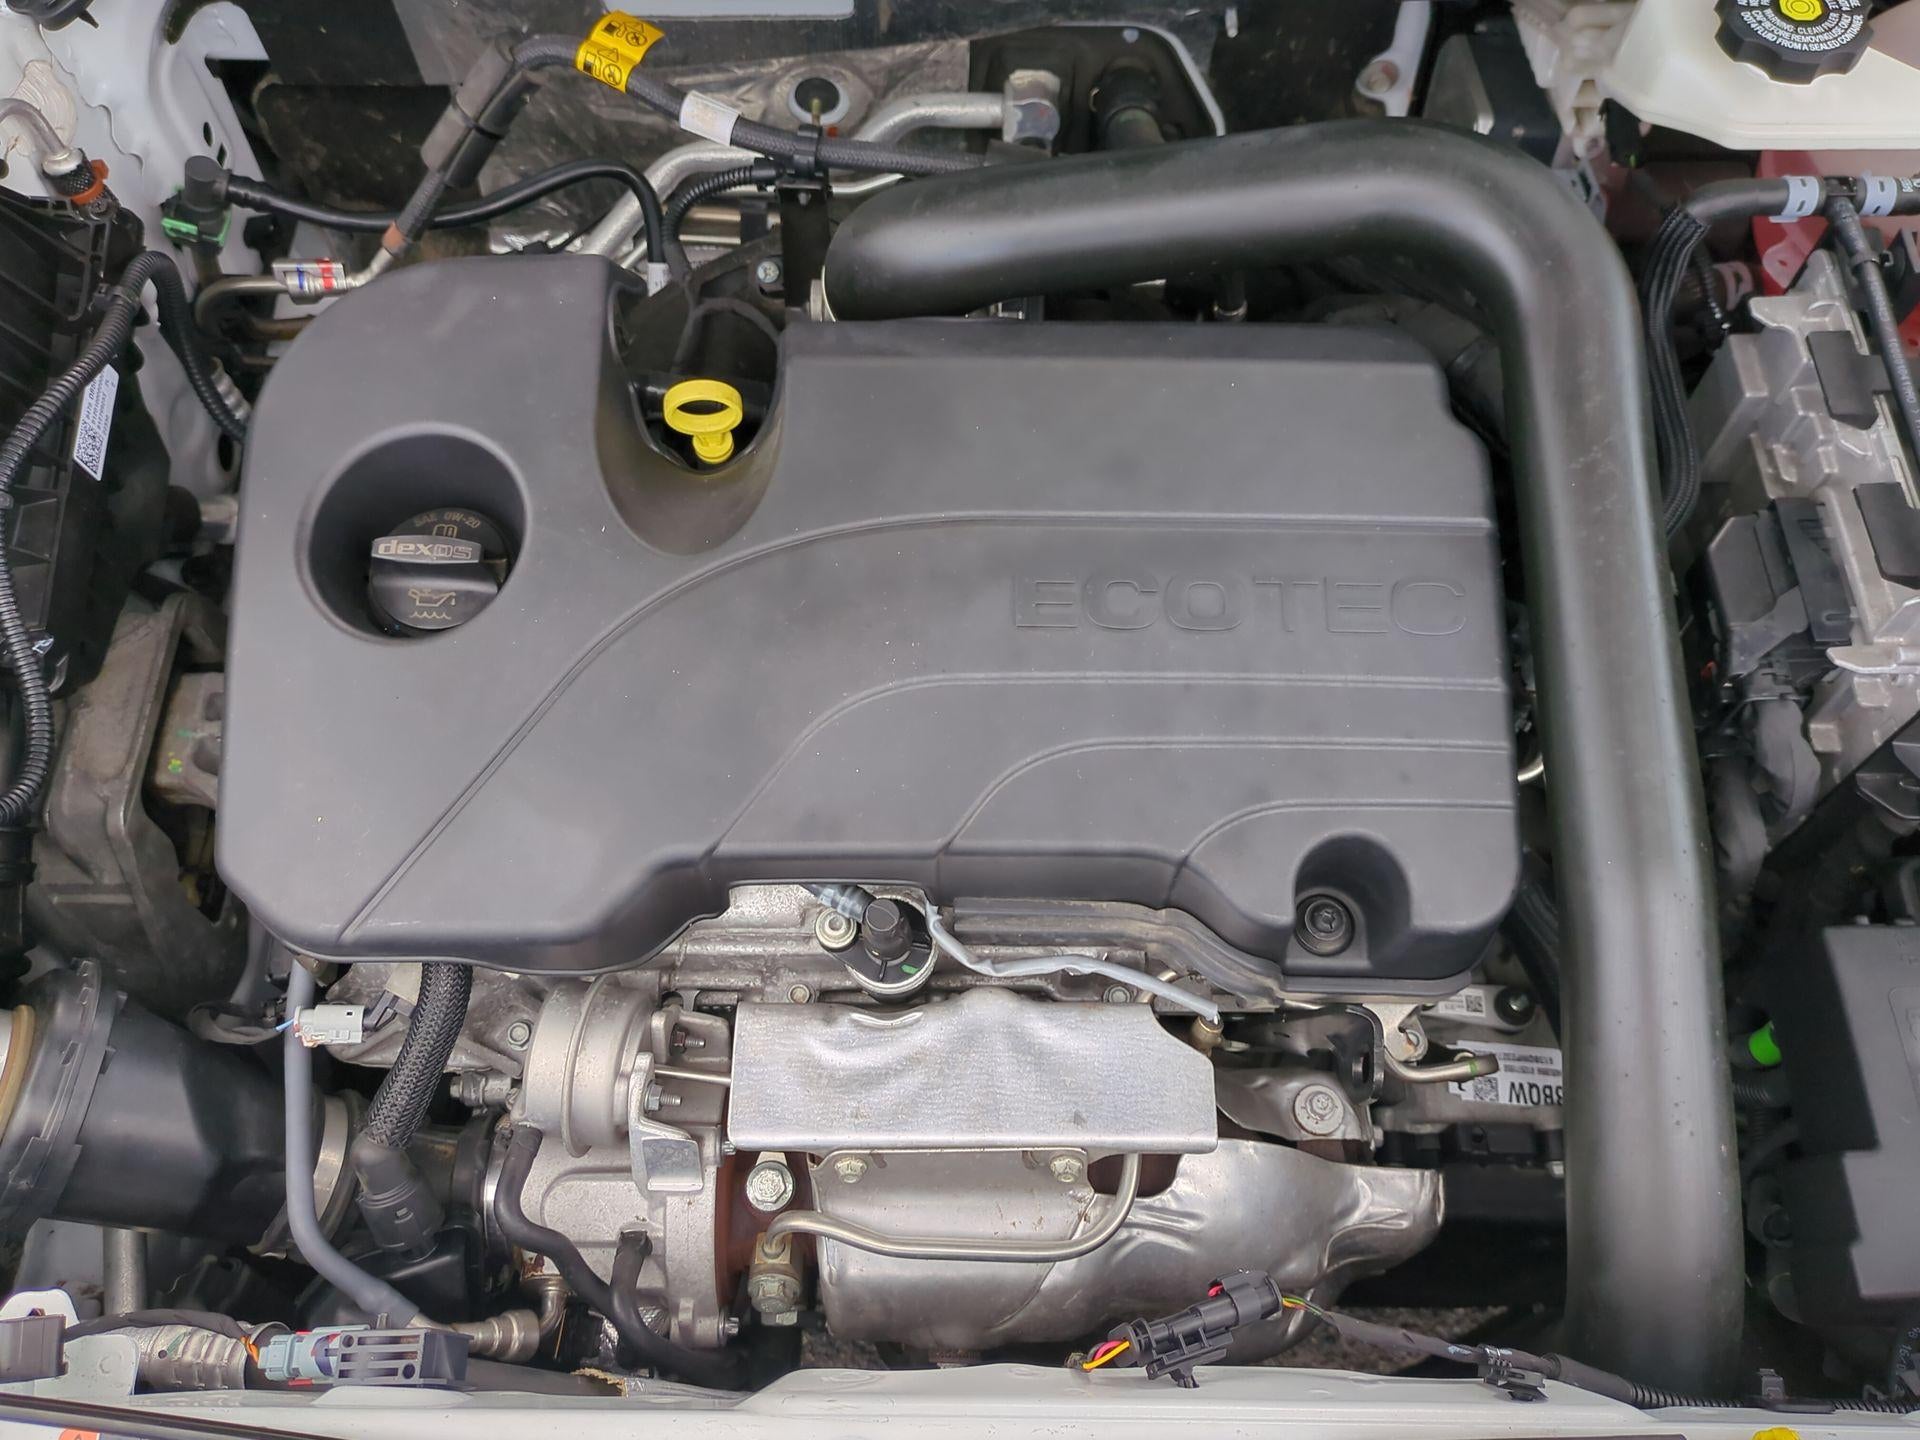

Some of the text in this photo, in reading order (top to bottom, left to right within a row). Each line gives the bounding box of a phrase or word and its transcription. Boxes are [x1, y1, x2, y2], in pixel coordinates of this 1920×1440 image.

[1740, 11, 1756, 24] DOT
[1754, 25, 1777, 41] FLUID
[1776, 37, 1801, 50] FROM
[1802, 43, 1810, 51] A
[1808, 39, 1840, 51] SEALED
[1752, 10, 1766, 22] CAP
[1761, 21, 1791, 40] BEFORE
[1797, 26, 1824, 35] CLEAN
[377, 540, 473, 560] dexos
[1014, 574, 1467, 636] ECOTEC
